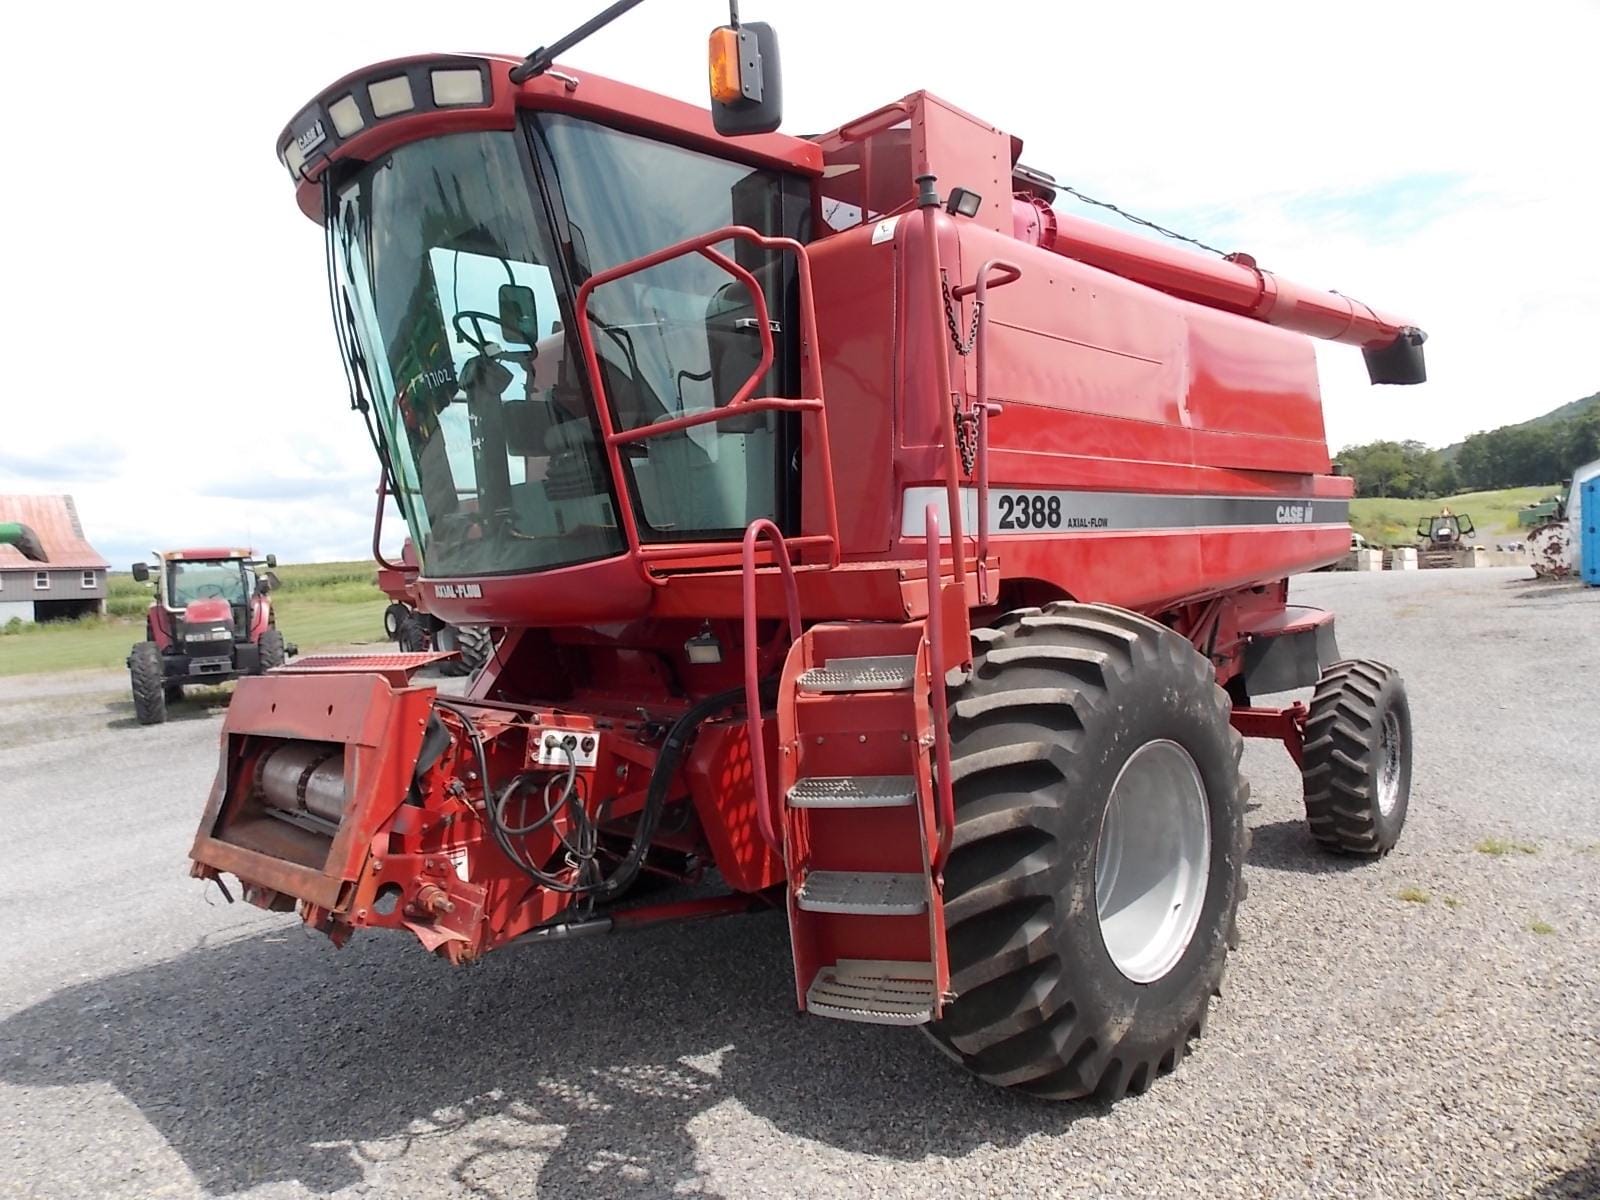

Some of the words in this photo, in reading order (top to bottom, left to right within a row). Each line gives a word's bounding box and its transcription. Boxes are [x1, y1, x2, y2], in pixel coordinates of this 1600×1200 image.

[297, 126, 318, 150] CASE
[999, 495, 1061, 529] 2388
[1276, 505, 1304, 523] CASE
